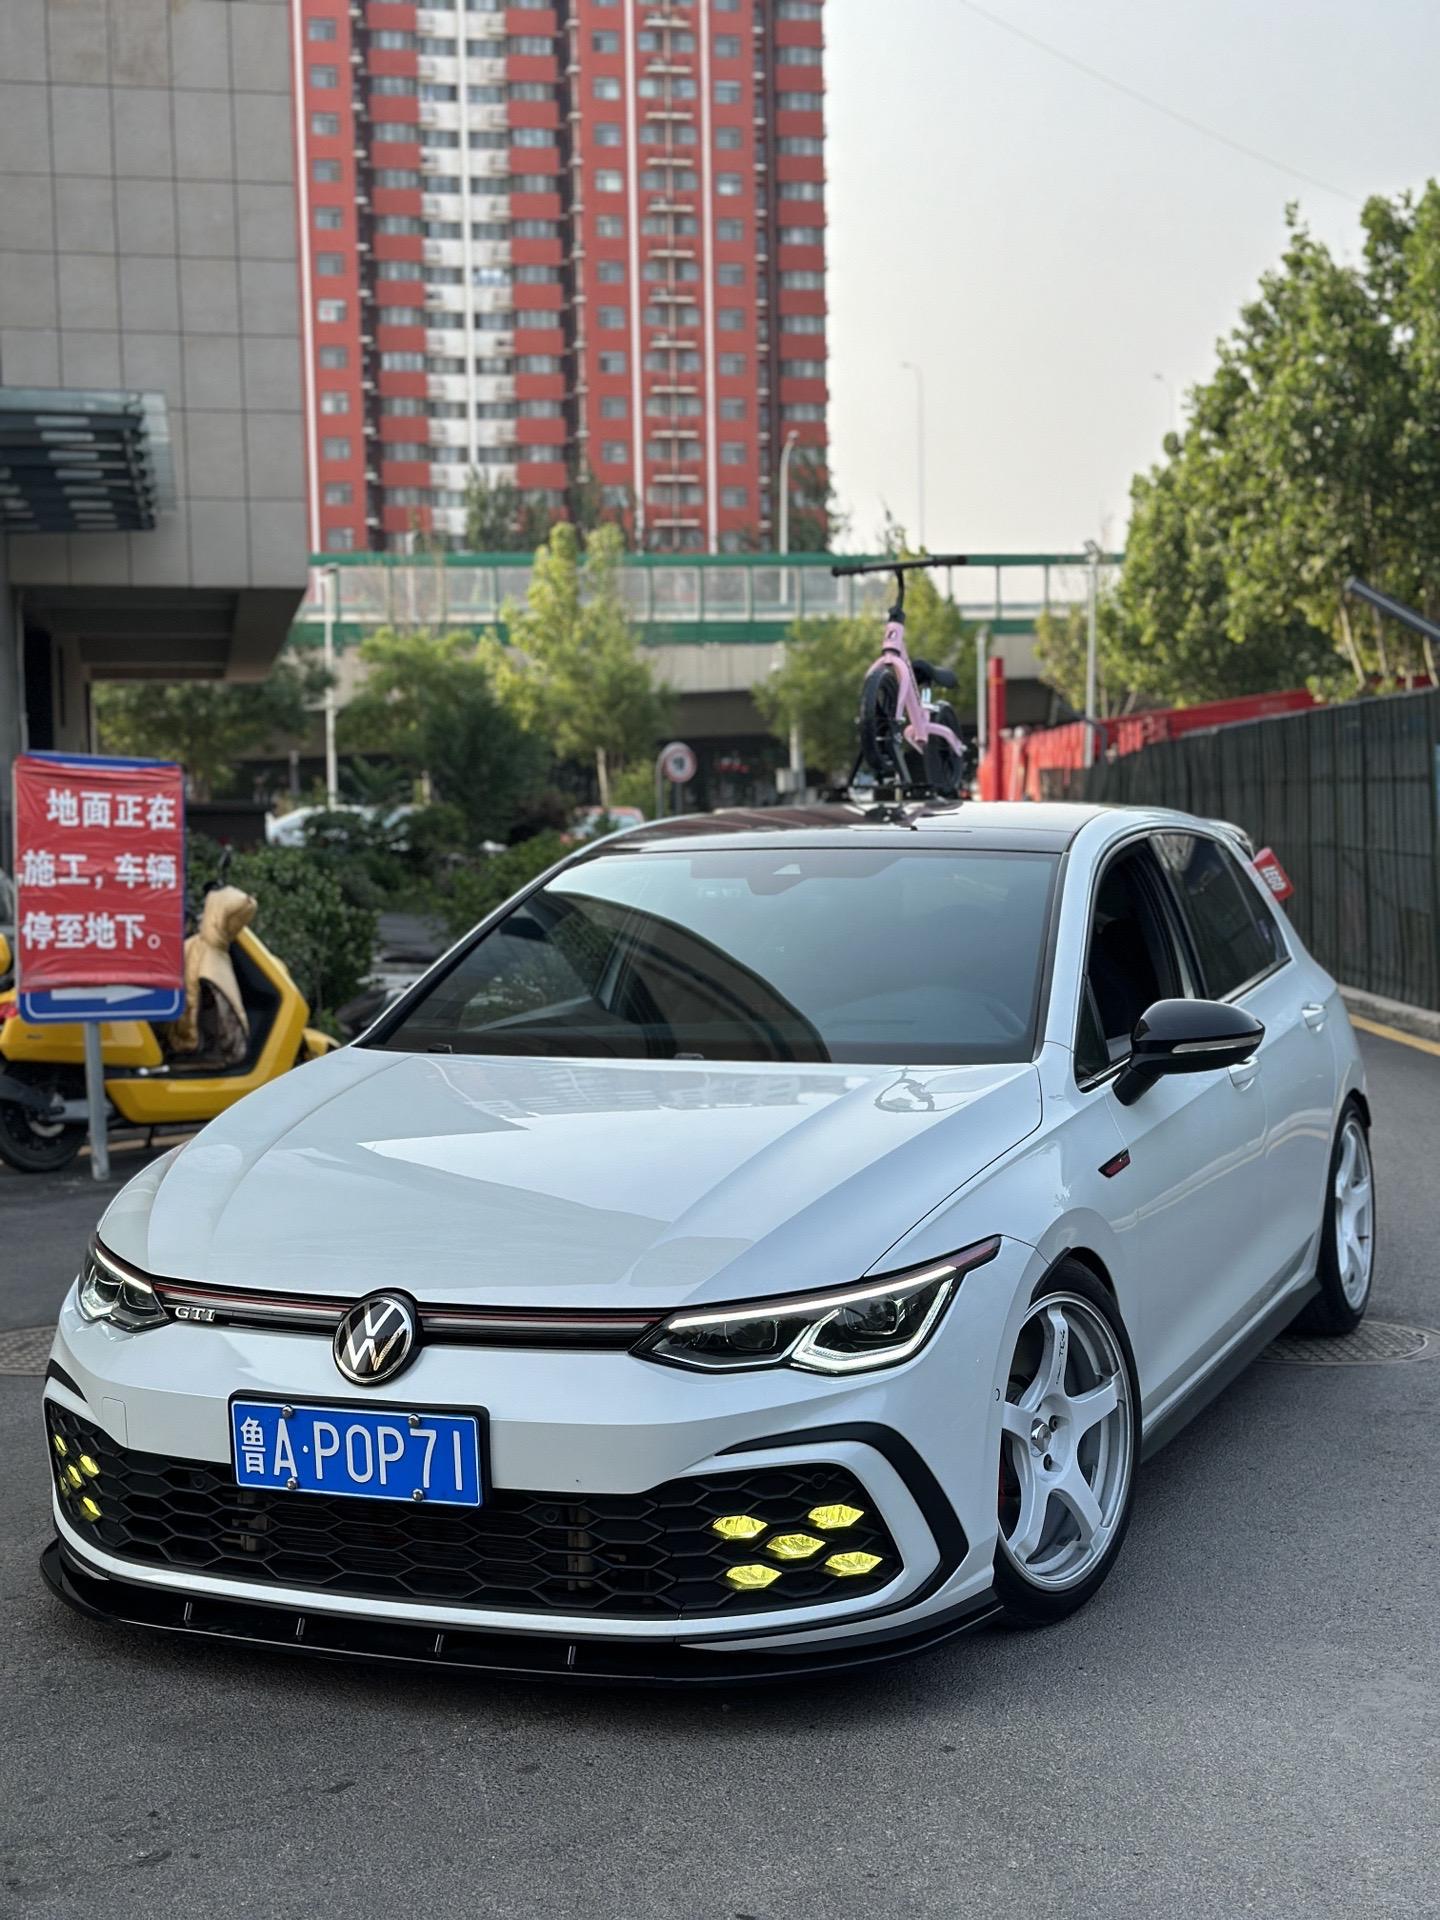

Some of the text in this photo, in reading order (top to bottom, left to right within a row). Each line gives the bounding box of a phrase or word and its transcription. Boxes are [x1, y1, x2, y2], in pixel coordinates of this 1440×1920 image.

[46, 788, 176, 830] 地面正在
[21, 911, 161, 949] 停至地下。
[174, 1306, 215, 1322] GTI
